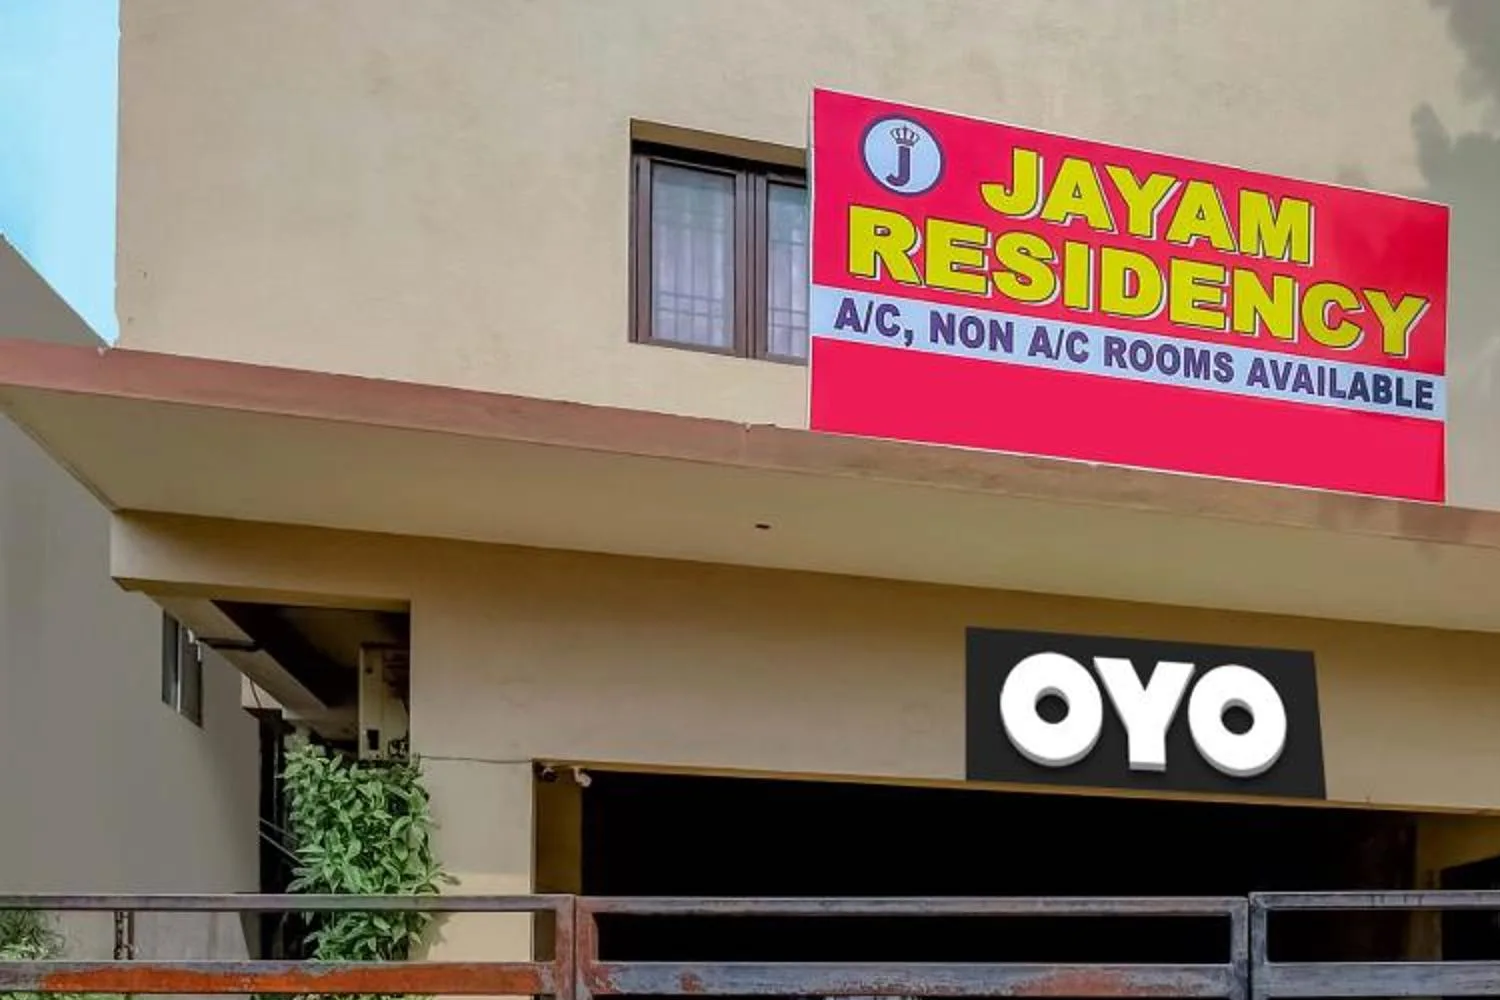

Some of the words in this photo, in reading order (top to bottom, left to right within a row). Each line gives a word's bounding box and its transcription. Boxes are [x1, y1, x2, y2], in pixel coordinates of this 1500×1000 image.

[886, 144, 912, 187] J
[981, 147, 1315, 265] JAYAM
[847, 204, 1430, 357] RESIDENCY
[834, 298, 913, 347] A/C,
[930, 313, 1014, 354] NON
[1028, 327, 1089, 363] A/C
[1103, 336, 1235, 384] ROOMS
[1247, 359, 1435, 410] AVAILABLE
[1000, 651, 1287, 777] OYO
